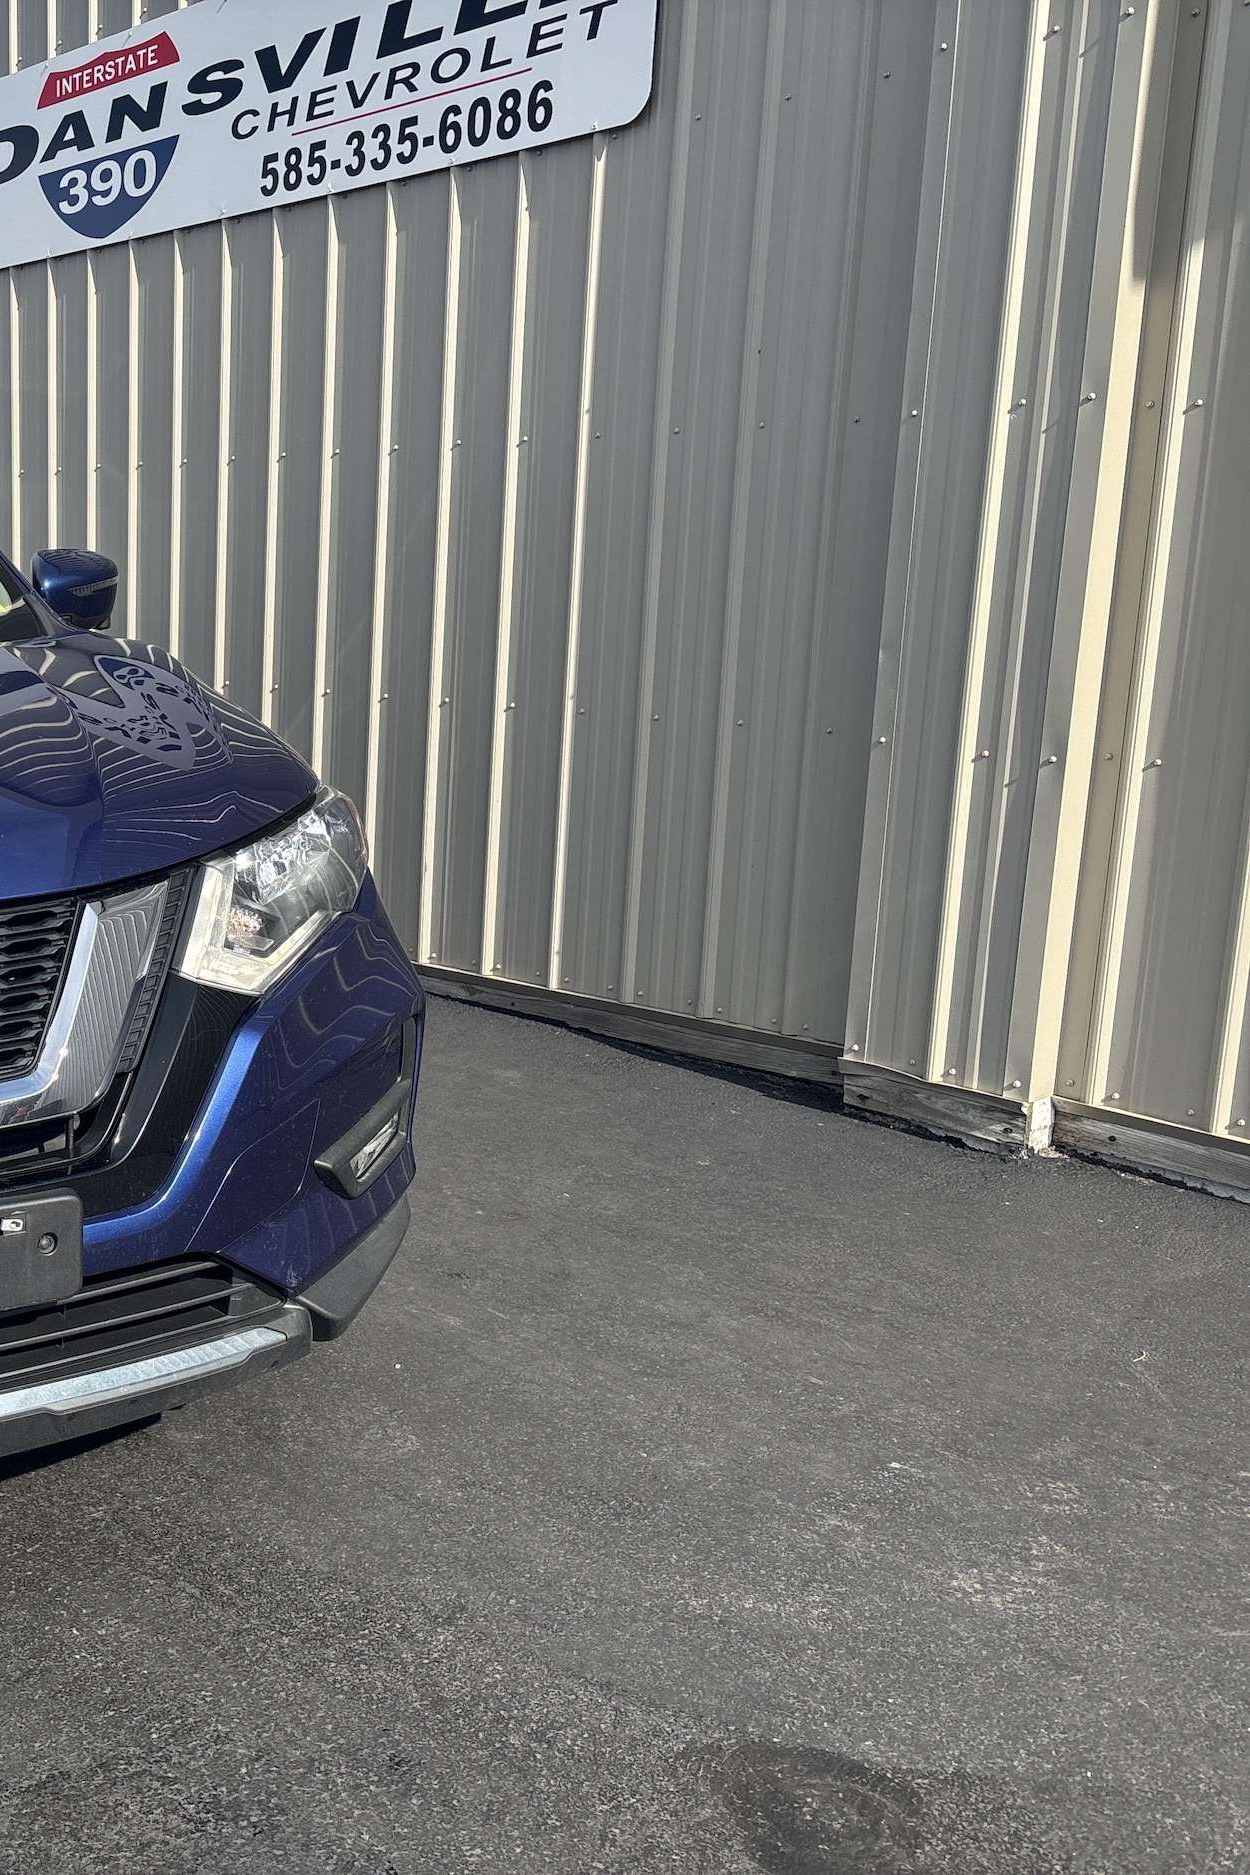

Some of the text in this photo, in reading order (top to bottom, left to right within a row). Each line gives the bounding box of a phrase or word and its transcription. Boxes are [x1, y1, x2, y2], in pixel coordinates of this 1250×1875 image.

[55, 44, 159, 98] INTERSTATE
[231, 0, 618, 140] CHEVROLET
[58, 150, 156, 214] 390
[260, 80, 554, 197] 585-335-6086
